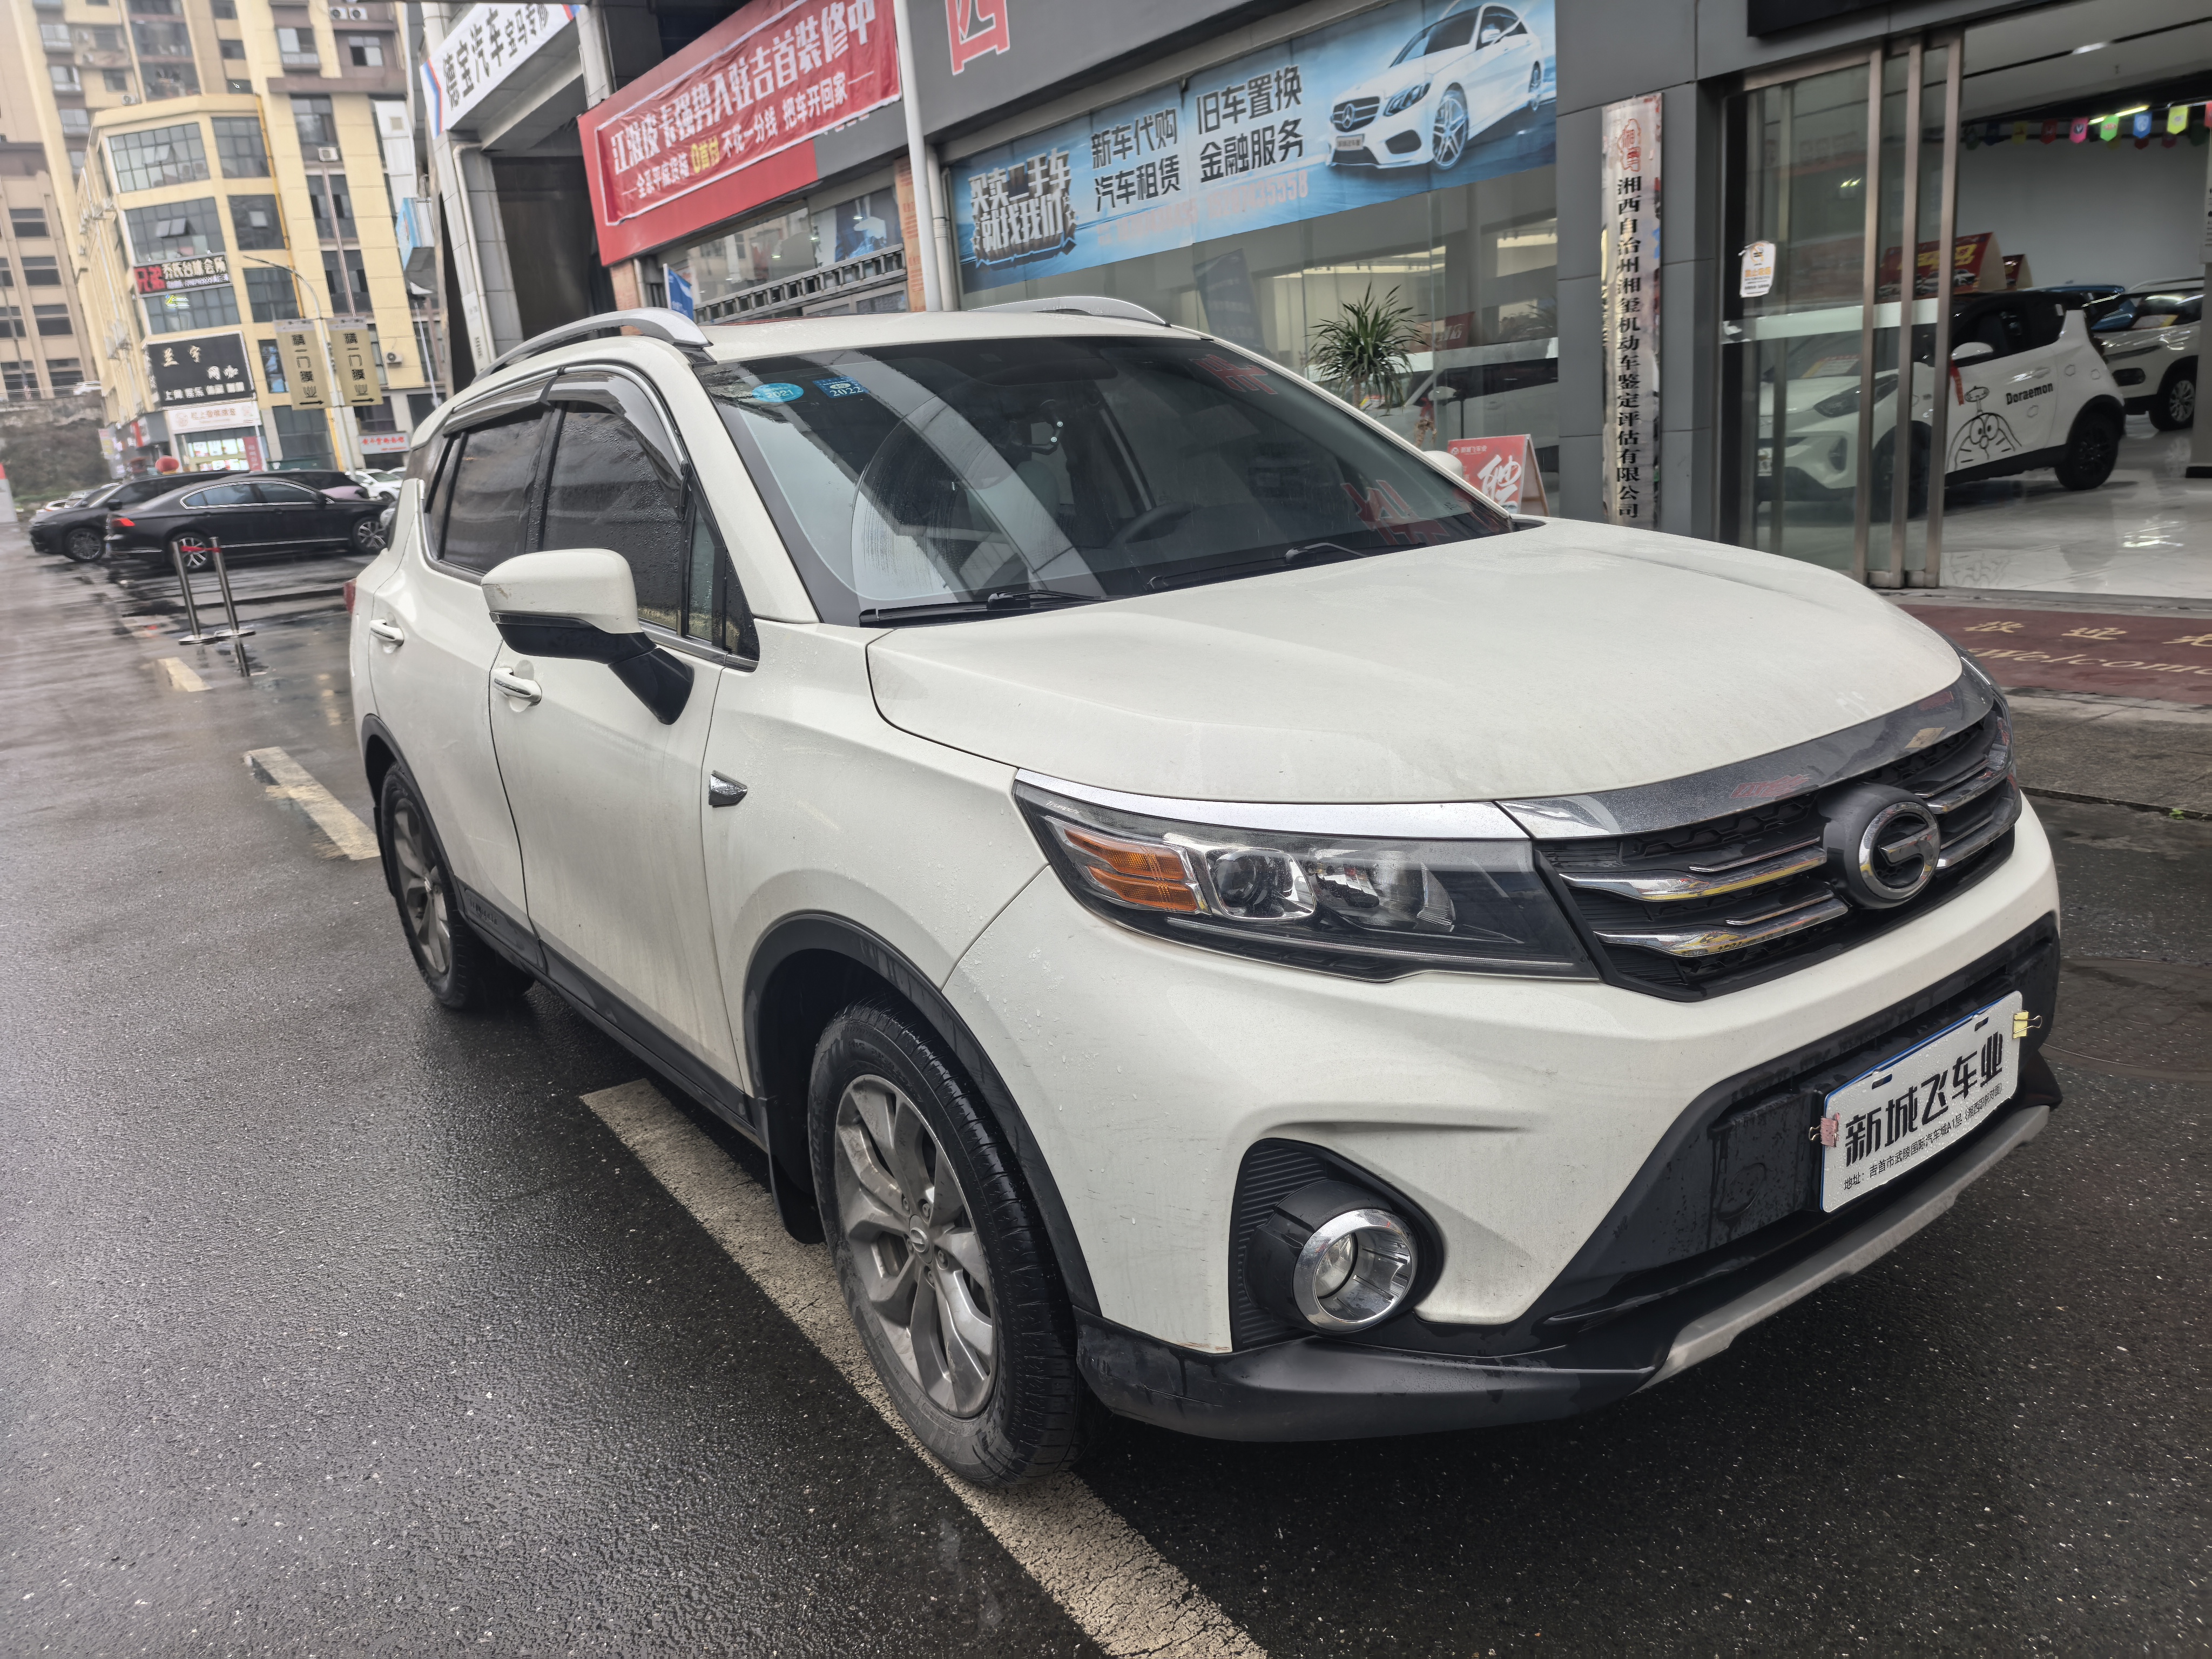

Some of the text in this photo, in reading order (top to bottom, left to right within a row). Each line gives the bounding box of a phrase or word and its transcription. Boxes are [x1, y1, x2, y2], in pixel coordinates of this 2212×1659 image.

[611, 0, 875, 174] 江淮皮卡强势入驻吉首装修中
[1091, 65, 1303, 169] 新车代购 旧车置换
[1095, 118, 1303, 211] 汽车租赁 金融服务
[765, 389, 794, 399] 2021
[830, 387, 864, 397] 2022
[1616, 176, 1642, 518] 湘西自治州湘玺机动车鉴定评估有限公司
[2006, 383, 2054, 405] Doraemon
[1845, 1031, 2002, 1167] 新城飞车业
